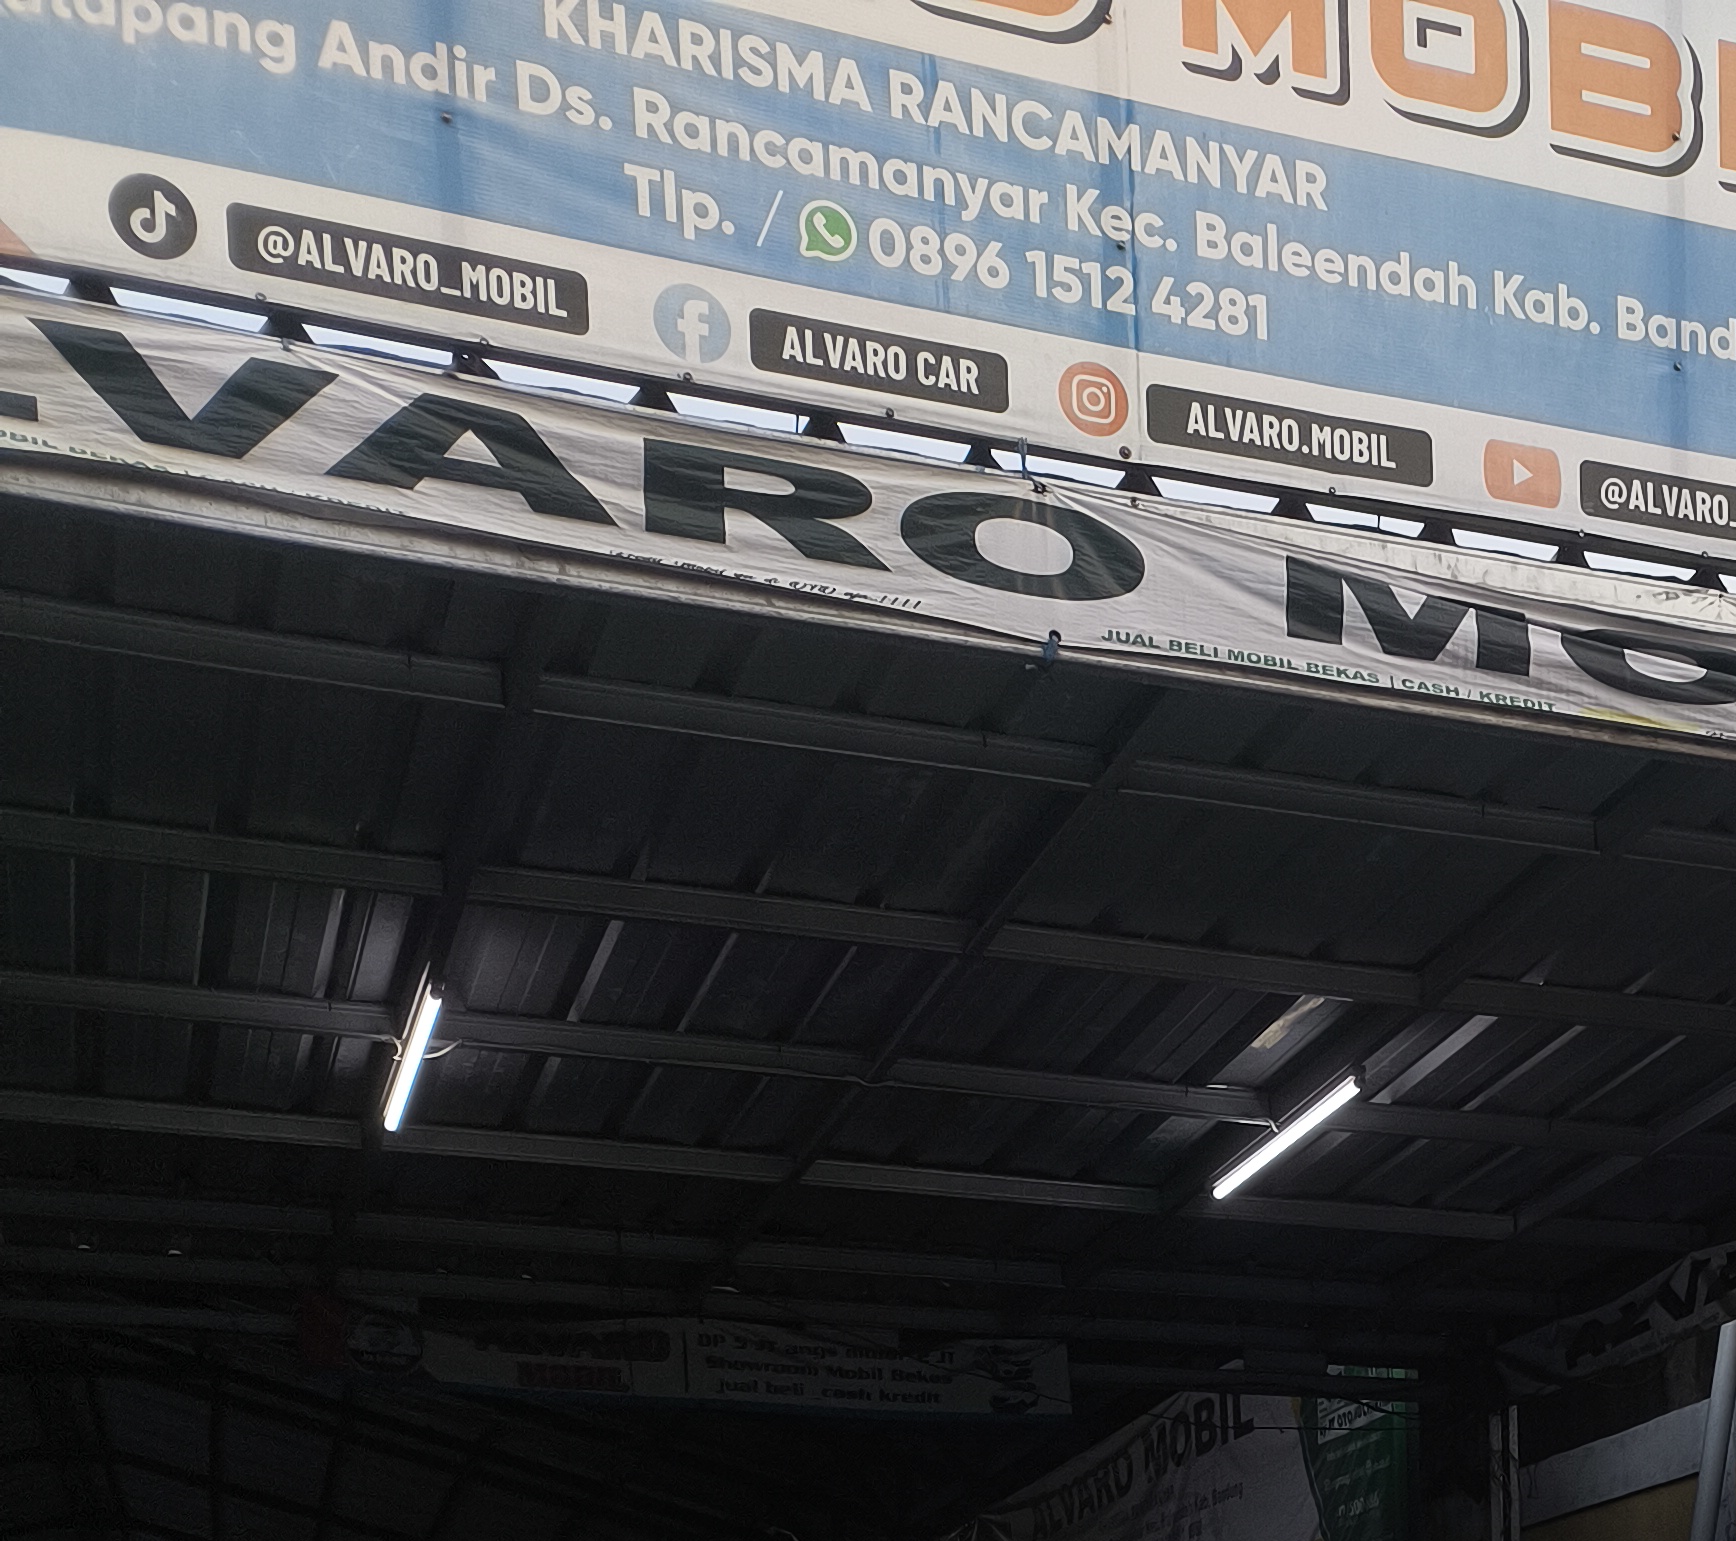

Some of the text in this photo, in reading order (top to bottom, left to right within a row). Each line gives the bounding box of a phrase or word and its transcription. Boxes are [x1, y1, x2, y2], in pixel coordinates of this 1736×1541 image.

[545, 0, 1328, 211] KHARISMA RANCAMANYAR
[318, 19, 498, 104] Andir
[516, 60, 612, 132] Ds.
[634, 86, 1050, 226] Rancamanyar
[1066, 184, 1177, 252] Kec.
[1197, 211, 1477, 310] Baleendah
[1495, 271, 1601, 335] Kab.
[257, 224, 568, 319] @ALVARO_MOBIL
[624, 163, 736, 240] Tlp.
[869, 218, 1011, 289] 0896
[1028, 250, 1135, 317] 1512
[1151, 275, 1270, 342] 4281
[783, 326, 980, 395] ALVARO CAR
[0, 318, 1146, 602] VARO
[1187, 401, 1397, 470] ALVARO.MOBIL
[1100, 628, 1162, 650] JUAL
[1168, 637, 1219, 660] BELI
[1227, 647, 1300, 672] MOBIL
[1305, 660, 1380, 686] BEKAS
[1402, 677, 1460, 699] CASH
[1479, 689, 1558, 713] KREDIT
[1143, 1390, 1256, 1485] MOBIL
